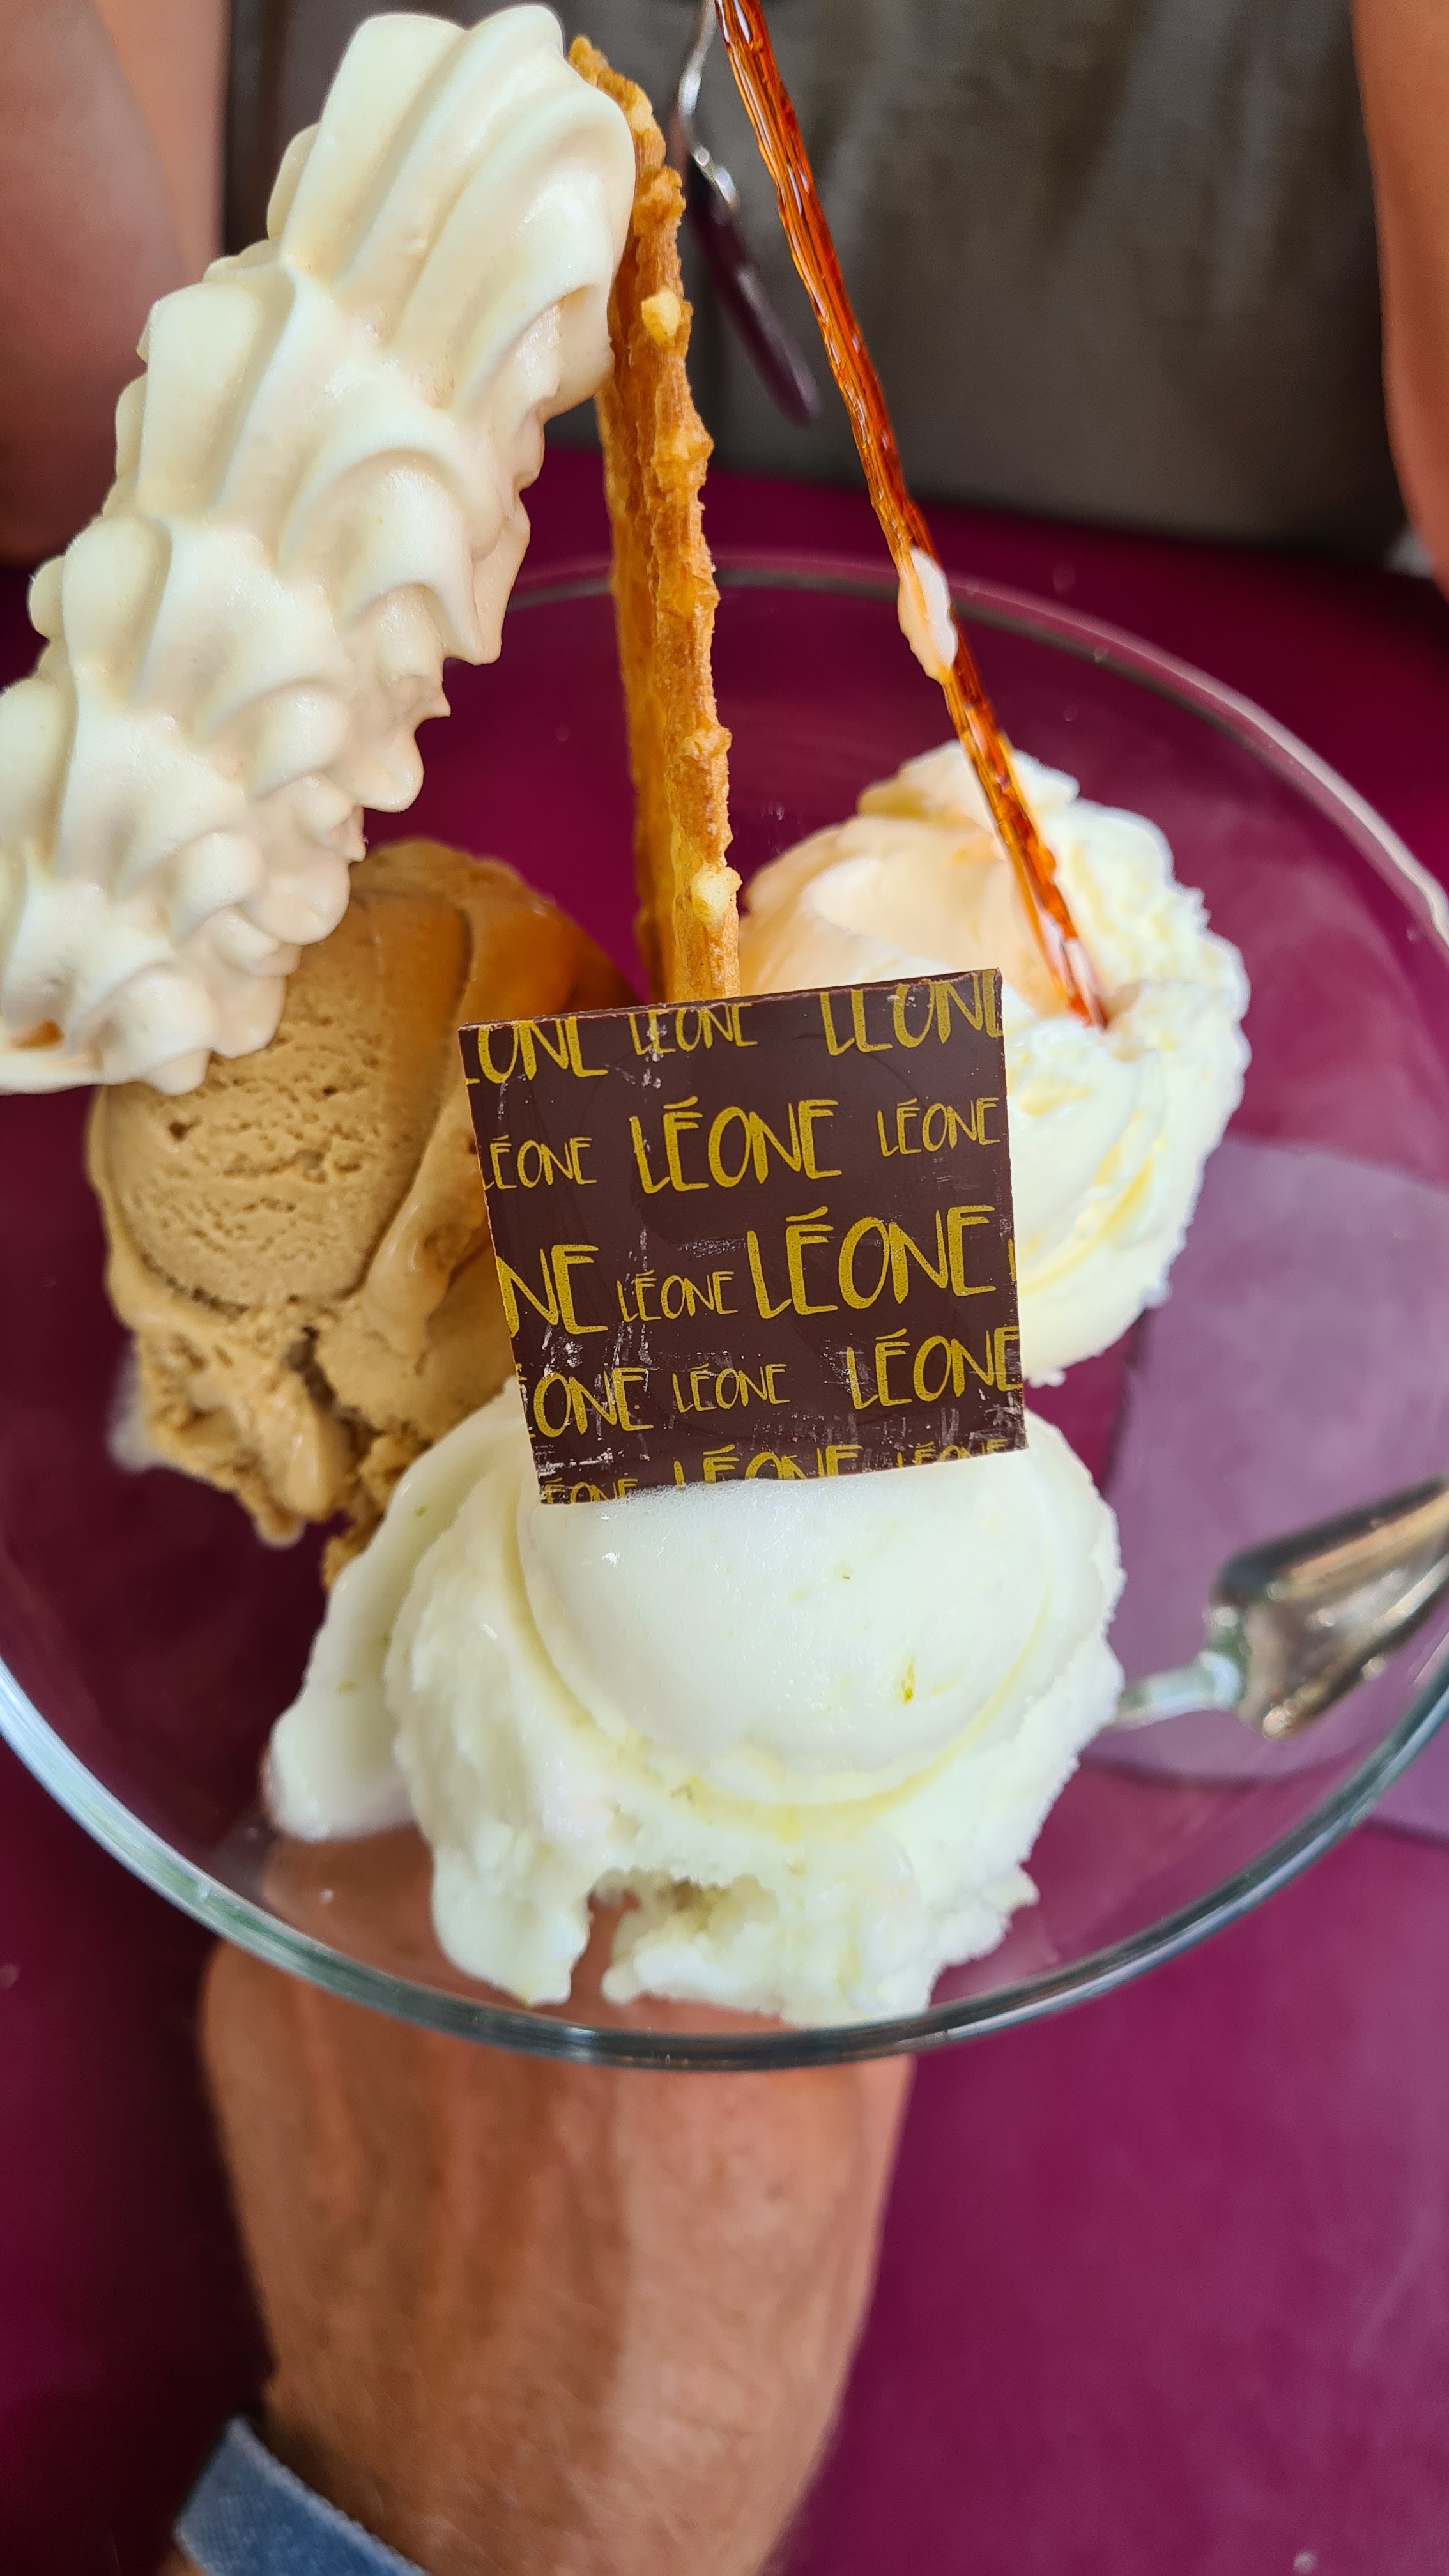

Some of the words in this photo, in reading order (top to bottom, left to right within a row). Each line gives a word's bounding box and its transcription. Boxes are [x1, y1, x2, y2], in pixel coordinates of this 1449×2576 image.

[466, 1016, 608, 1084] ONE
[629, 1096, 842, 1194] LÉONE
[877, 1097, 1001, 1158] LÉONE
[617, 1269, 738, 1322] LÉONE
[746, 1206, 996, 1319] LÉONE
[516, 1363, 654, 1438] ONE
[672, 1363, 791, 1413] LÉONE
[847, 1328, 1022, 1410] LÉONE
